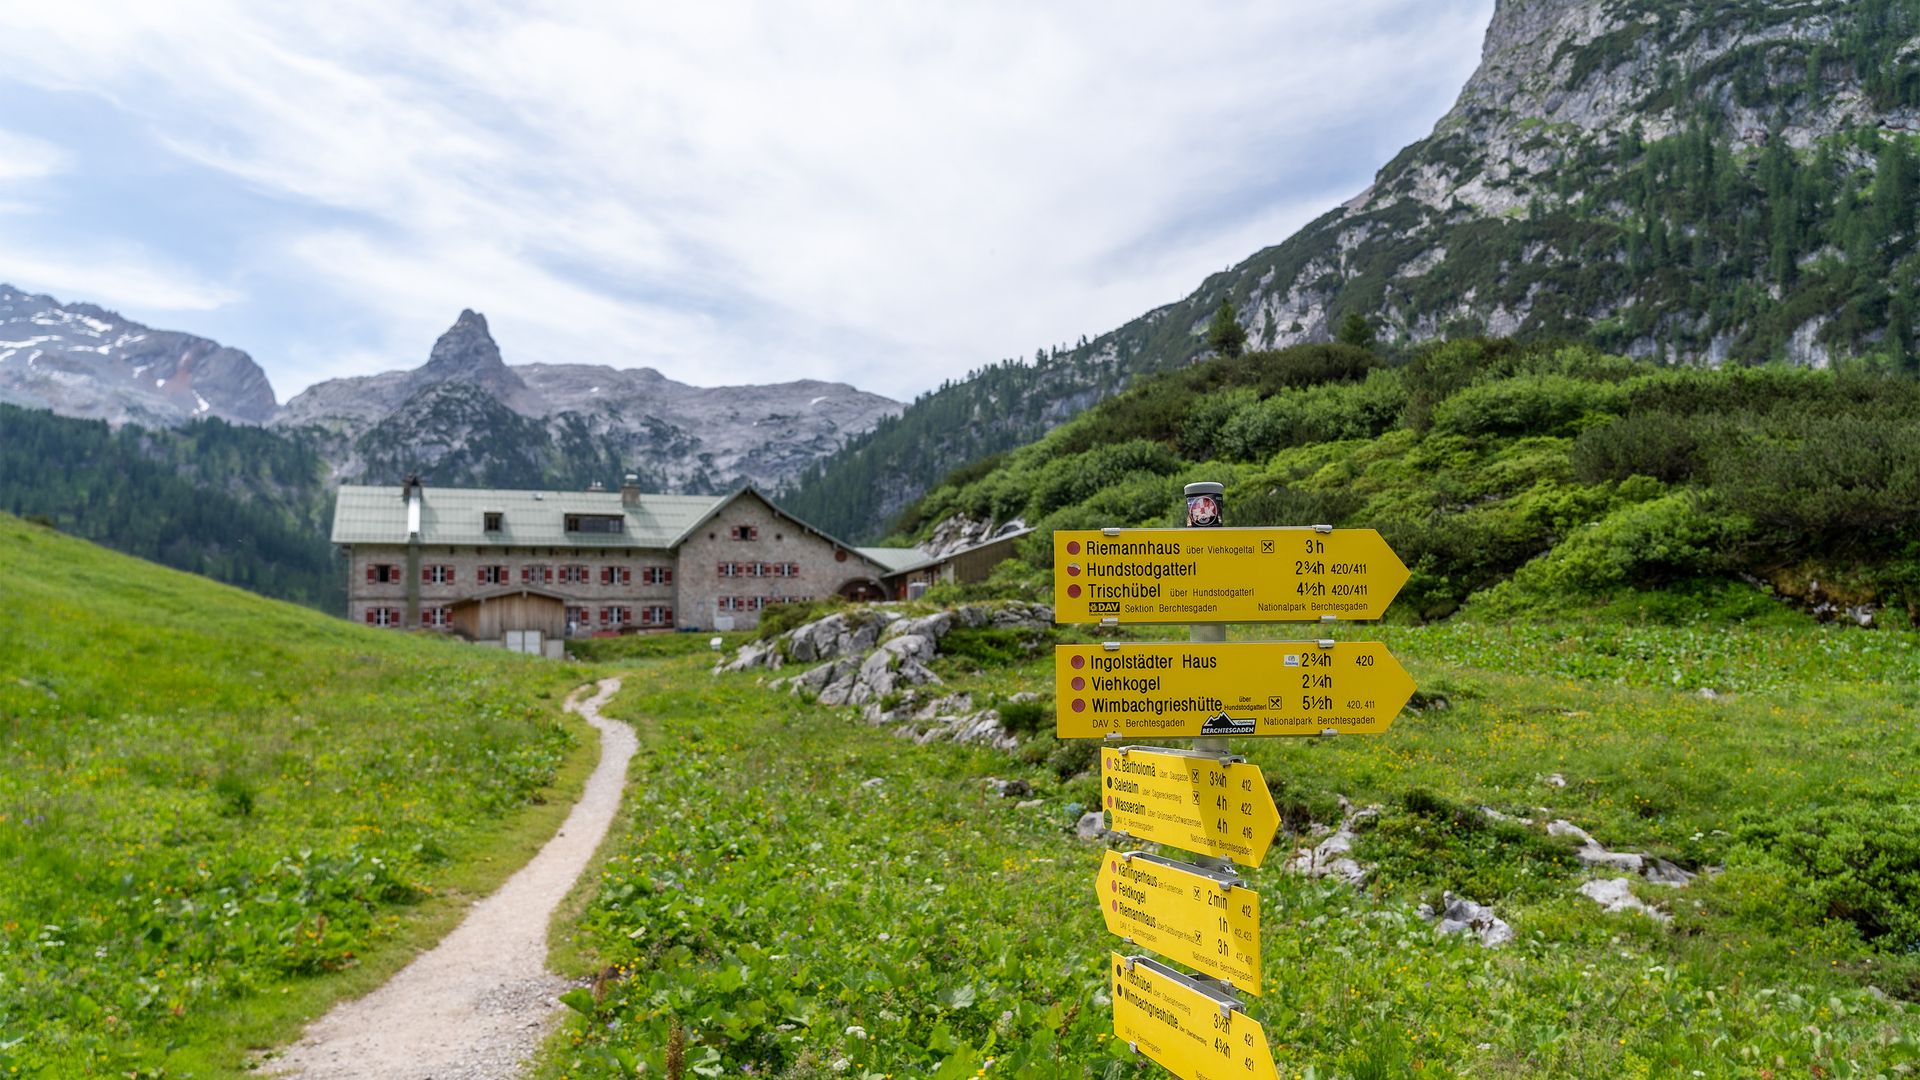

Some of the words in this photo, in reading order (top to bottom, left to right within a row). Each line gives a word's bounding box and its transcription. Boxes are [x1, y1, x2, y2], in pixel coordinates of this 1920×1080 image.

[1086, 541, 1180, 556] Riemannhaus
[1186, 546, 1204, 554] über
[1208, 546, 1254, 556] Viehkogeltal
[1306, 540, 1313, 553] 3
[1317, 540, 1324, 553] h
[1087, 562, 1196, 579] Hundstodgatterl
[1331, 564, 1366, 574] 420/411
[1088, 583, 1160, 598] Trischübel
[1170, 589, 1187, 597] über
[1192, 588, 1254, 598] Hundstodgatterl
[1332, 585, 1368, 596] 420/411
[1098, 603, 1118, 611] DAV
[1125, 604, 1153, 613] Sektion
[1159, 604, 1217, 614] Berchtesgaden
[1258, 603, 1306, 612] Nationalpark
[1311, 602, 1368, 612] Berchtesgaden
[1090, 654, 1173, 672] Ingolstädter
[1182, 654, 1217, 669] Haus
[1356, 656, 1374, 666] 420
[1092, 676, 1160, 693] Viehkogel
[1092, 697, 1222, 715] Wimbachgrieshütte
[1114, 719, 1120, 727] S.
[1126, 718, 1185, 729] Berchtesgaden
[1264, 717, 1312, 726] Nationalpark
[1318, 716, 1375, 726] Berchtesgaden
[1122, 758, 1156, 777] Bartholomä
[1242, 779, 1252, 792] 412
[1114, 777, 1138, 794] Saletalm
[1216, 795, 1221, 810] 4
[1222, 796, 1227, 811] h
[1241, 802, 1252, 815] 422
[1115, 797, 1146, 816] Wasseralm
[1217, 818, 1221, 832] 4
[1223, 818, 1228, 834] h
[1242, 826, 1252, 839] 416
[1191, 834, 1216, 846] Nationalpark
[1219, 840, 1252, 855] Berchtesgaden
[1119, 882, 1146, 905] Feldkogel
[1219, 916, 1222, 931] 1
[1223, 918, 1228, 933] h
[1208, 890, 1212, 905] 2
[1214, 894, 1227, 910] min
[1242, 904, 1251, 918] 412
[1119, 901, 1156, 928] Riemannhaus
[1218, 939, 1222, 954] 3
[1224, 941, 1228, 957] h
[1124, 987, 1178, 1029] Wimbachgrieshütte
[1245, 1057, 1254, 1072] 421
[1244, 1033, 1253, 1047] 421
